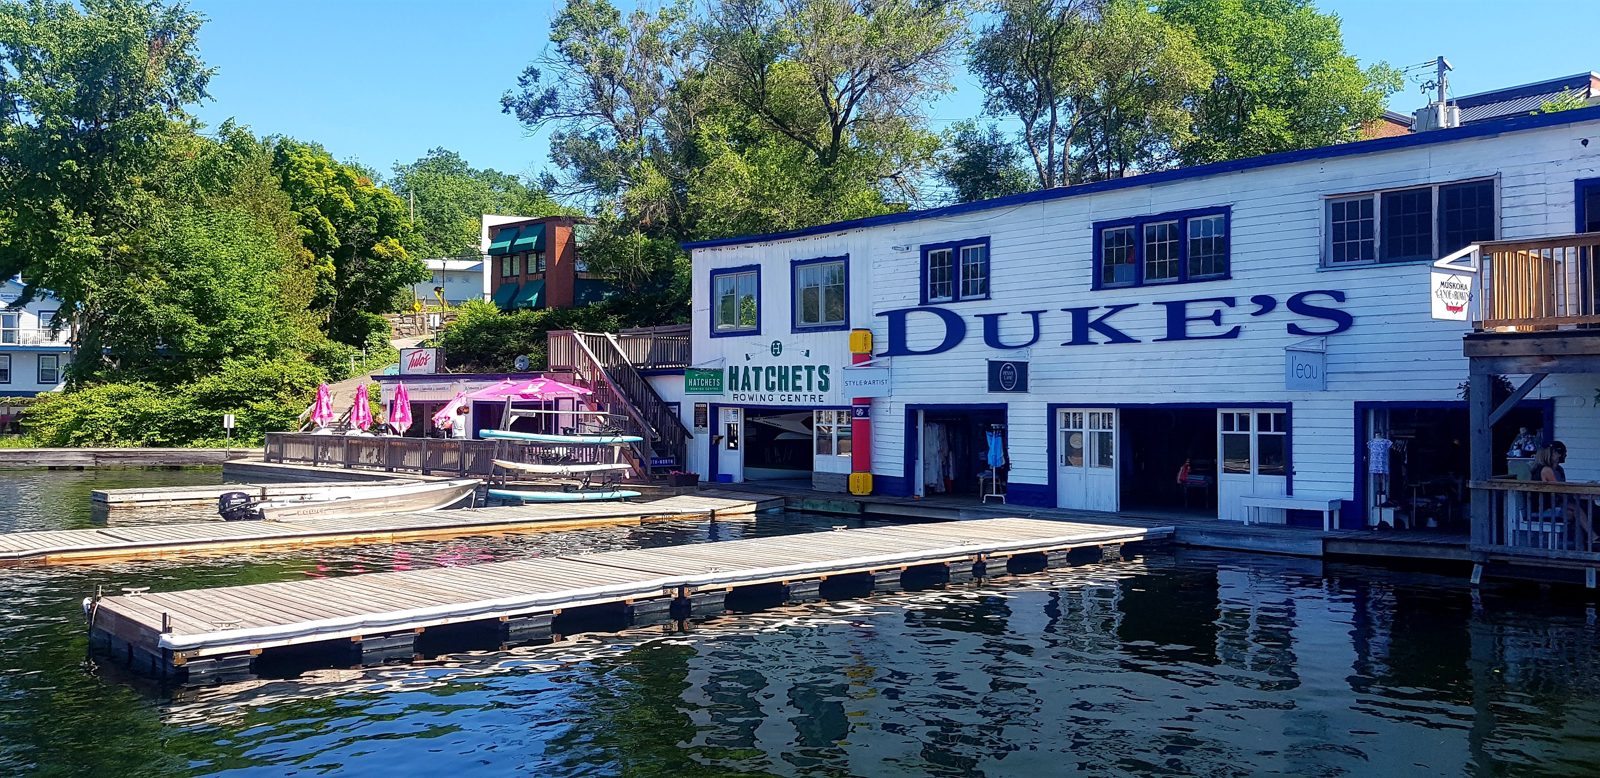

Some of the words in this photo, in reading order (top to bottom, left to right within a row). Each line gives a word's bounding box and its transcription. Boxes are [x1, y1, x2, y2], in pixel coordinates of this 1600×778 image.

[1440, 281, 1467, 290] MUSKOKA
[875, 289, 1354, 357] DUKE'S
[1291, 355, 1318, 380] l'eau
[688, 378, 721, 387] HATCHETS
[728, 365, 830, 393] HATCHETS
[732, 393, 774, 402] ROWING
[780, 394, 824, 403] CENTRE
